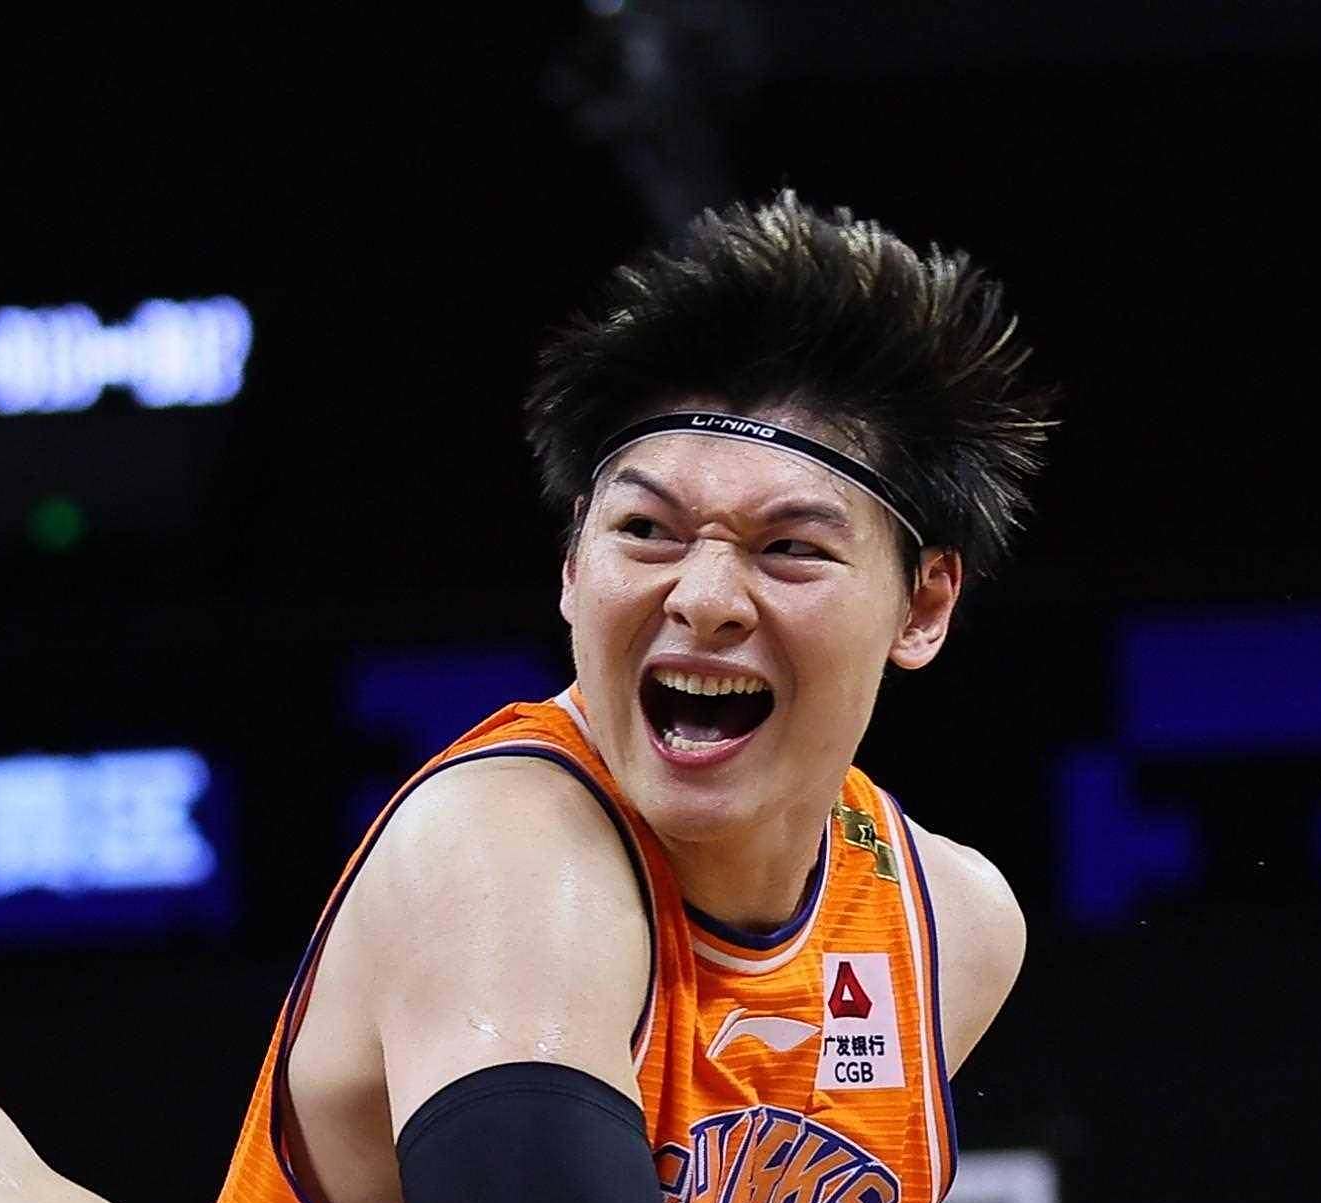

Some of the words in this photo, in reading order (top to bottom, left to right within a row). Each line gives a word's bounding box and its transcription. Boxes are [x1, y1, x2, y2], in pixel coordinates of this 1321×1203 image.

[691, 416, 776, 438] LI-NING
[823, 1035, 885, 1056] 广发银行
[835, 1062, 874, 1083] CGB
